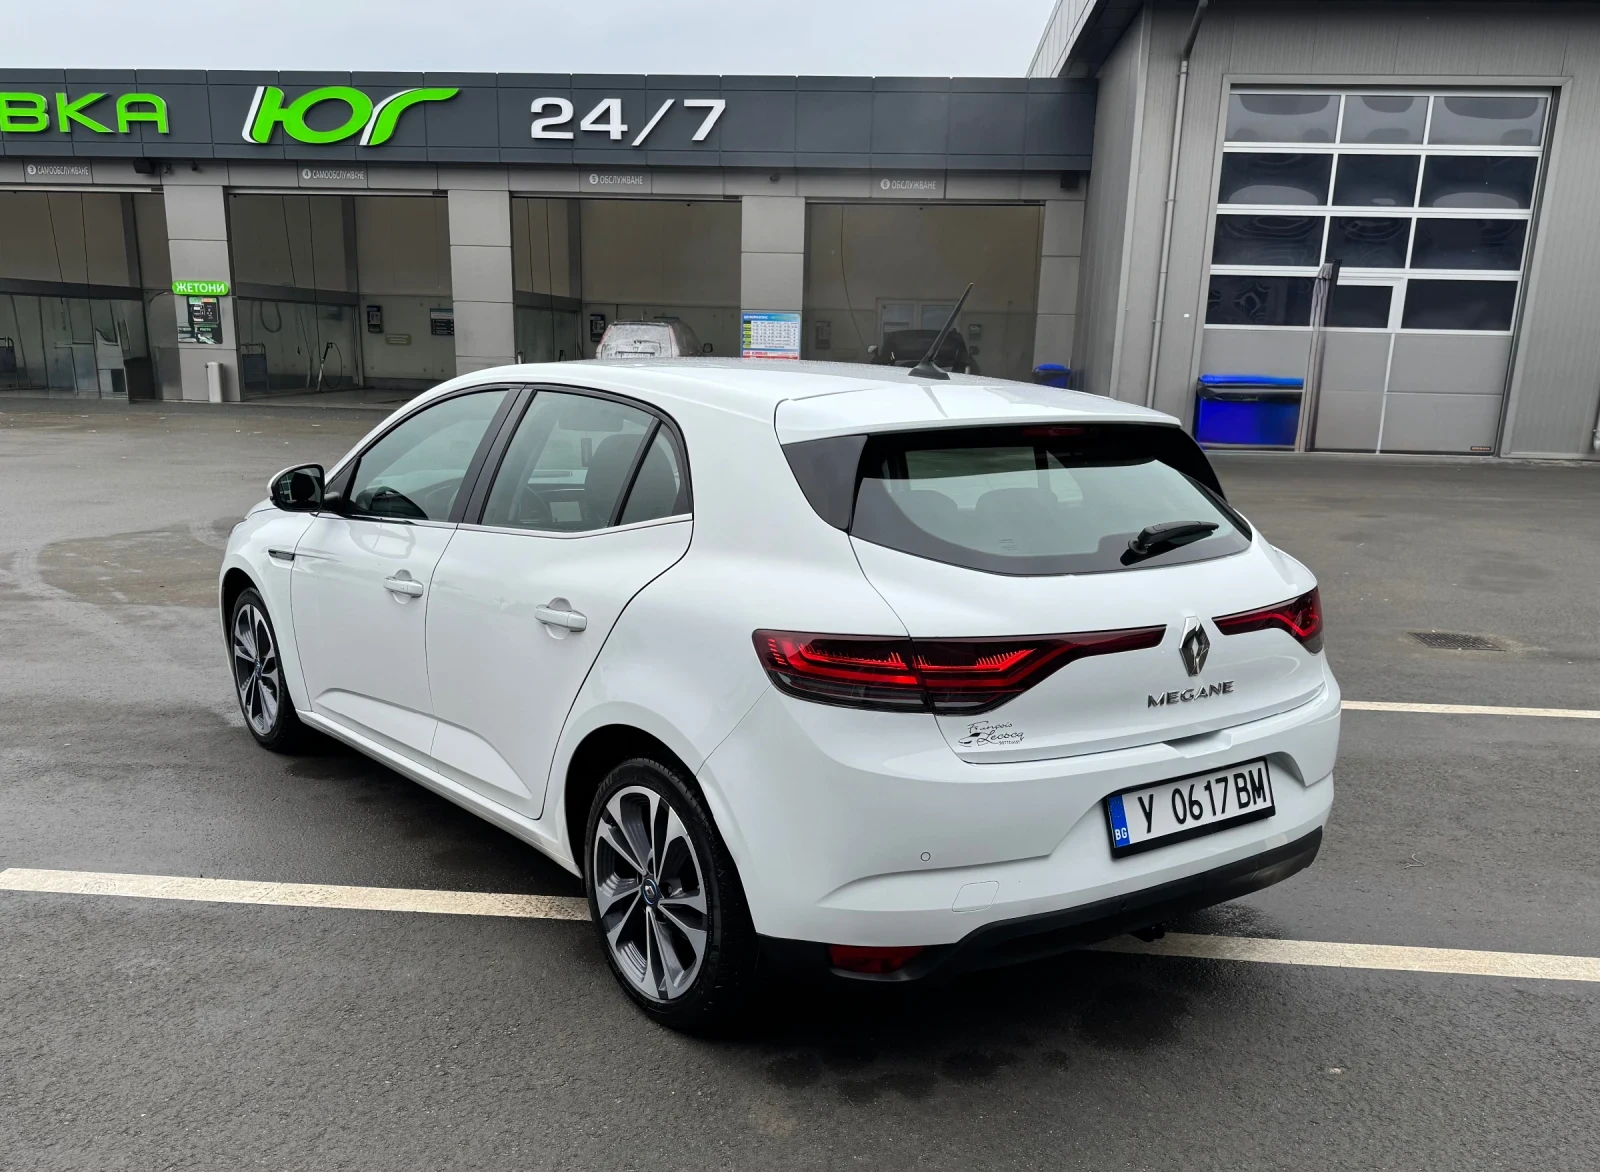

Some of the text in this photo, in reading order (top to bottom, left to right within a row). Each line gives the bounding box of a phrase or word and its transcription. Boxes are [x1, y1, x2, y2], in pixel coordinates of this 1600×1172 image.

[530, 97, 726, 146] 24/7
[600, 175, 643, 184] ОБСЛУЖВАНЕ
[891, 180, 936, 189] ОБСЛУЖВАНЕ
[176, 283, 225, 293] ЖЕТОНИ
[1147, 680, 1235, 708] MEGANE
[1115, 827, 1128, 841] BG
